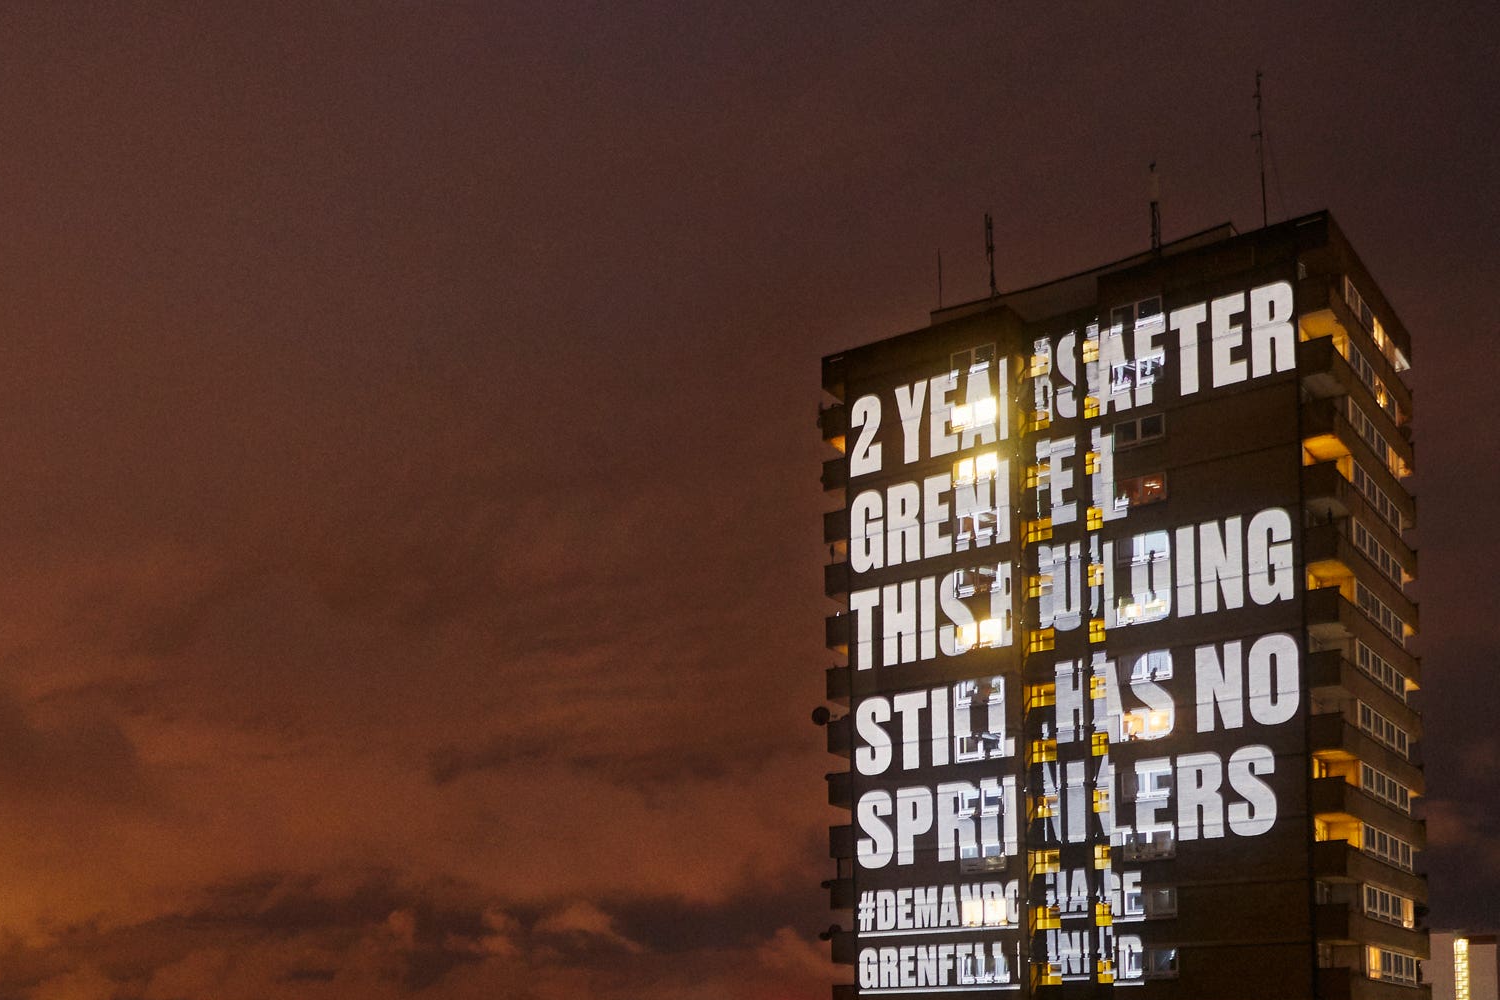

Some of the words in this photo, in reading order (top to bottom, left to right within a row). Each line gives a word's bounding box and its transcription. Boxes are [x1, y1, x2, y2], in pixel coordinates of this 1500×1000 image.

[851, 395, 882, 477] 2
[895, 319, 1100, 464] YEARS
[1098, 281, 1296, 416] AFTER
[851, 569, 978, 671] THIS
[855, 676, 1015, 776] STILL
[1048, 650, 1175, 743] HAS
[1195, 633, 1300, 733] NO
[857, 744, 1277, 868] SPRINKLERS
[858, 940, 1011, 989] GRENFELL
